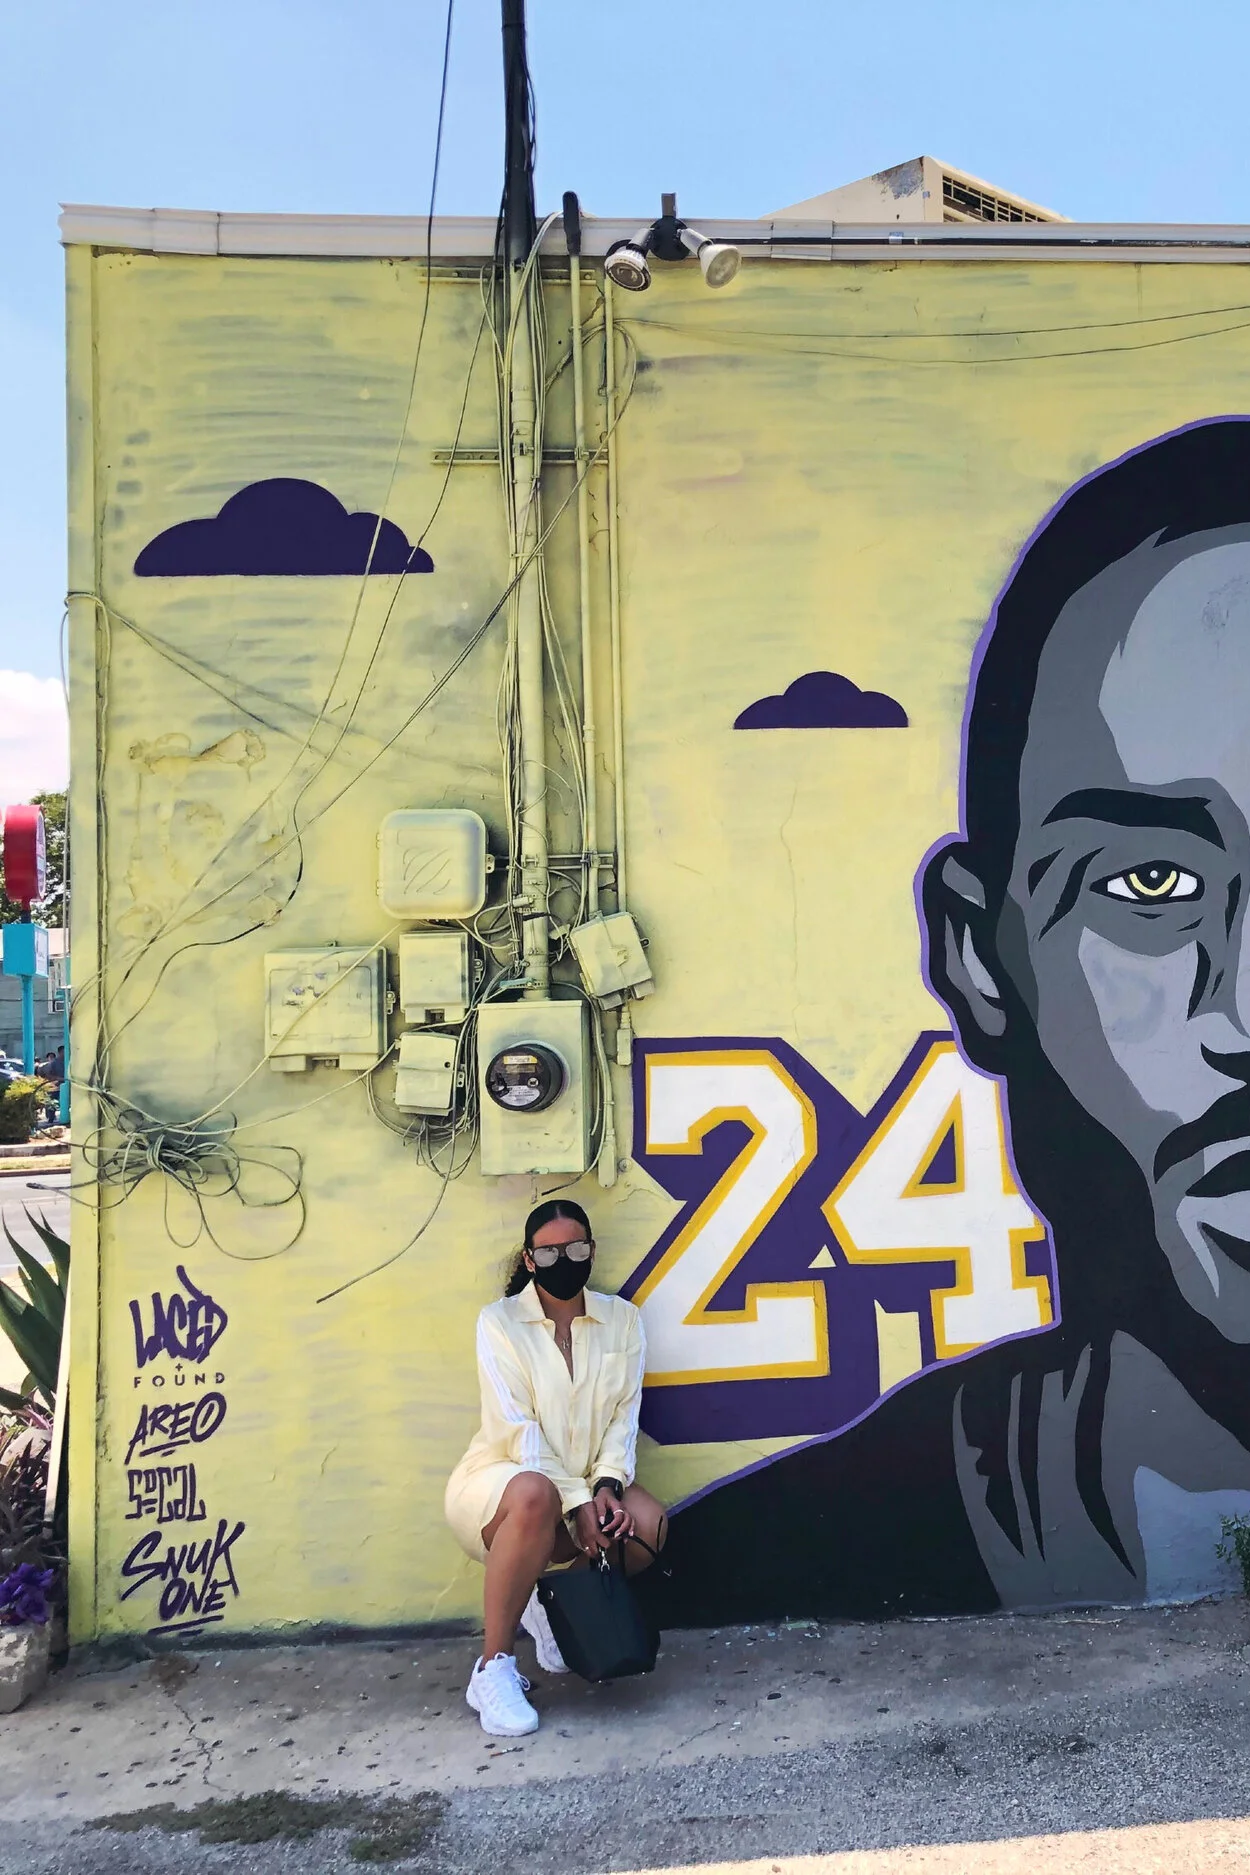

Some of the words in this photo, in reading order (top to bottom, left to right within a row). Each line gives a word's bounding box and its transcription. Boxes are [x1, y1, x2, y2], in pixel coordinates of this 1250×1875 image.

[630, 1039, 1056, 1388] 24
[133, 1372, 226, 1389] FOUND
[159, 1577, 227, 1621] ONE
